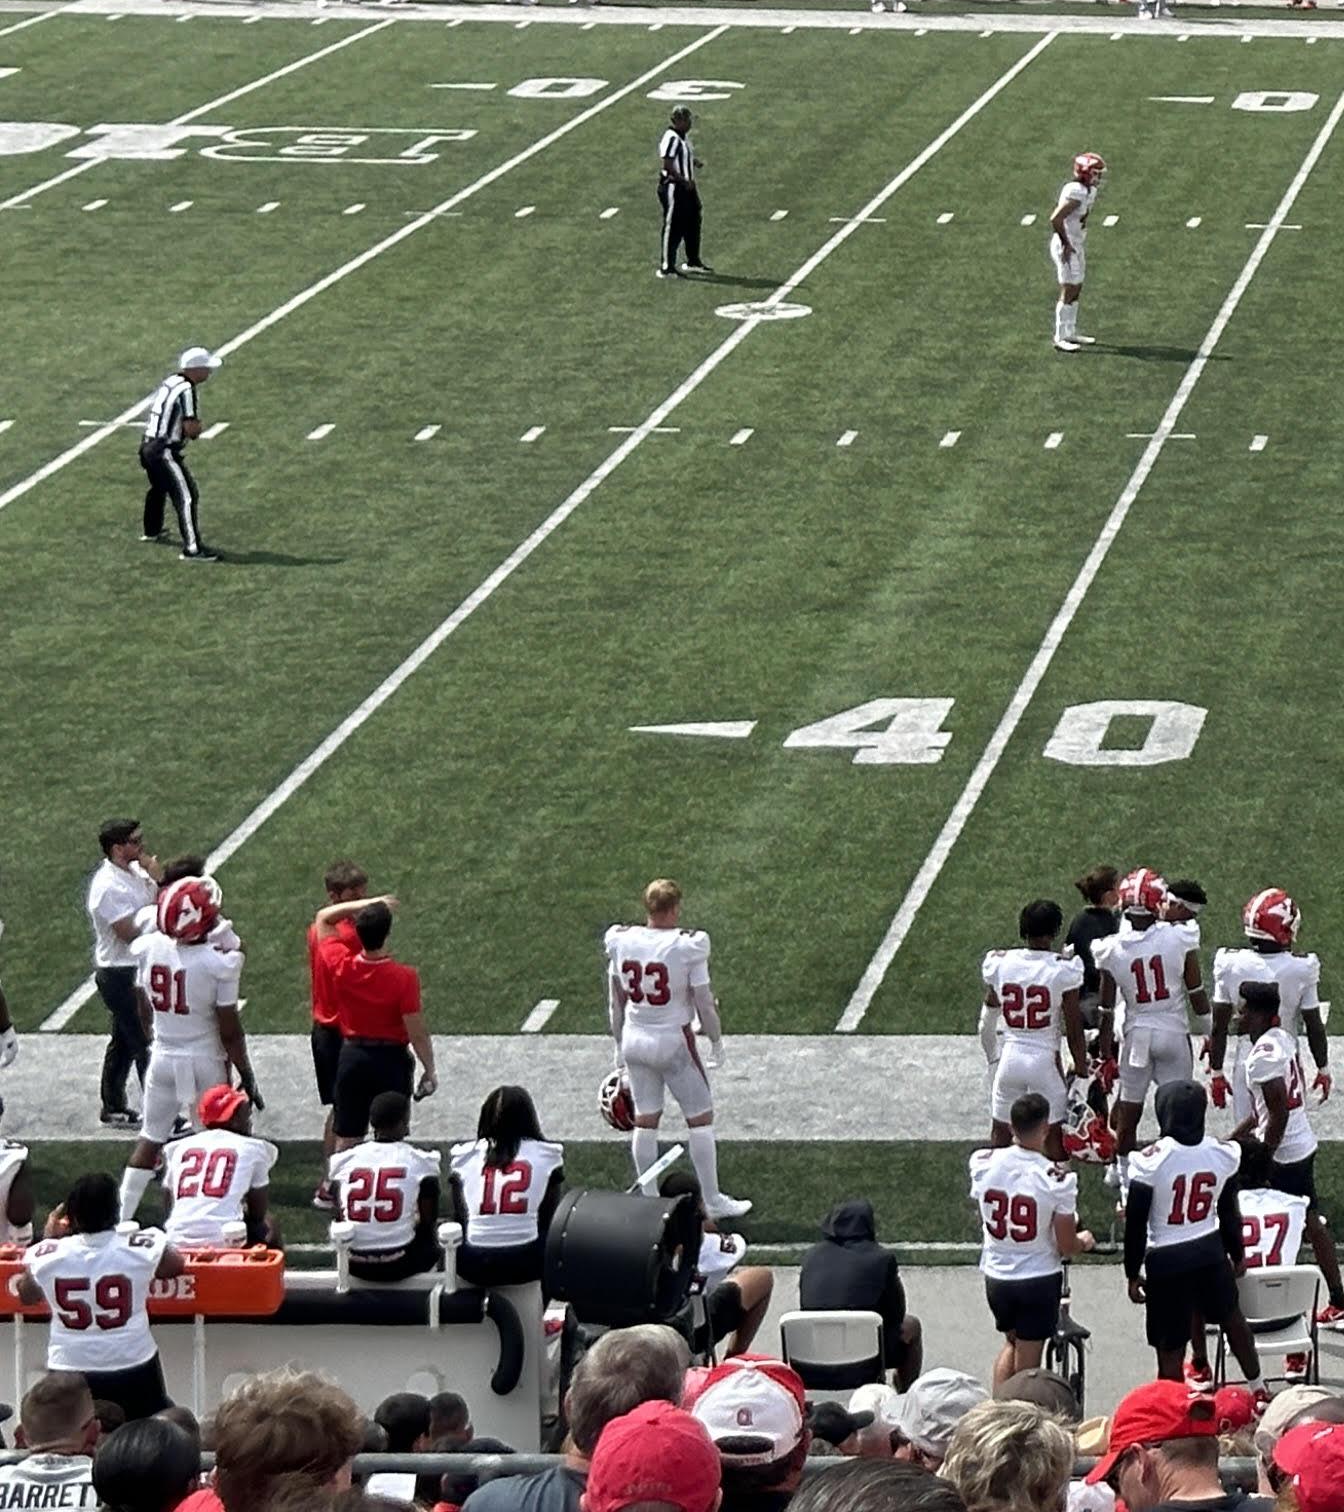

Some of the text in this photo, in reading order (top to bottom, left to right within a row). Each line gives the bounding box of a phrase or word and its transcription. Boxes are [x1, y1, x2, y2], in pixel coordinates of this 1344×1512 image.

[149, 964, 190, 1016] 91
[620, 960, 671, 1007] 33
[1129, 954, 1170, 1004] 11
[1001, 983, 1052, 1031] 22
[178, 1148, 238, 1199] 20
[346, 1166, 407, 1224] 25
[479, 1160, 532, 1215] 12
[1166, 1170, 1217, 1226] 16
[982, 1189, 1037, 1244] 39
[1240, 1211, 1291, 1268] 27
[53, 1274, 133, 1332] 59
